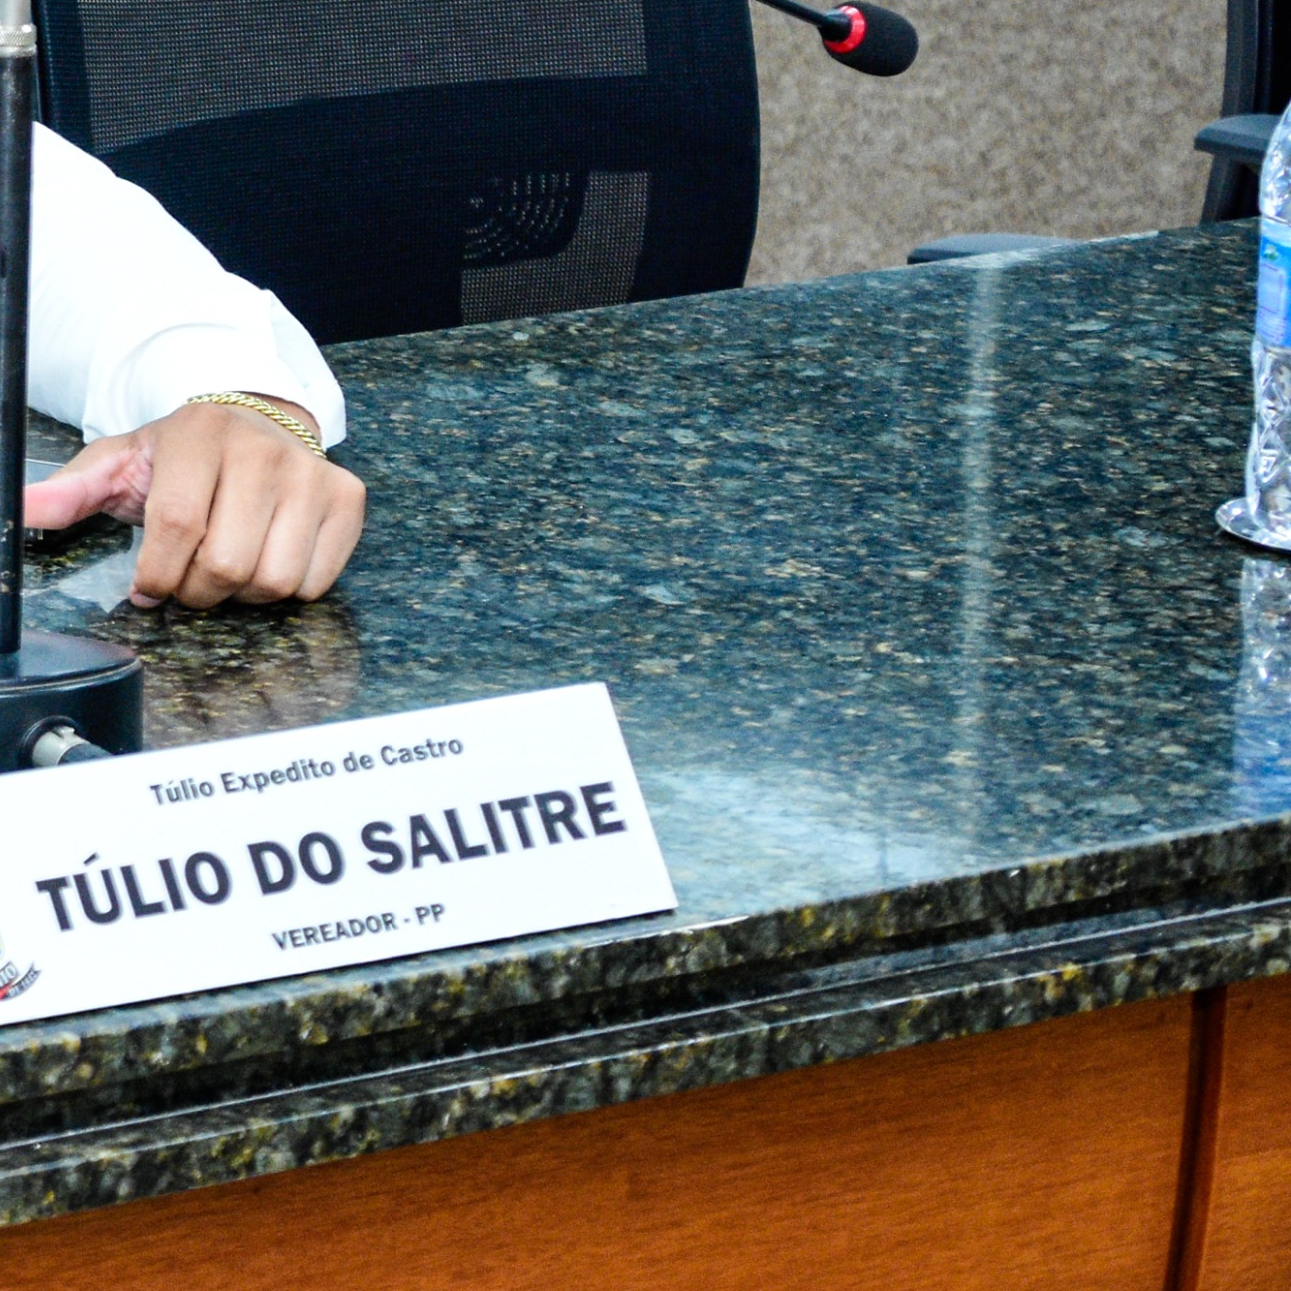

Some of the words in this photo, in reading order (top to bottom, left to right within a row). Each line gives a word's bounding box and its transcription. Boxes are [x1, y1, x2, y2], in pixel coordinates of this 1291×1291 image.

[149, 779, 215, 806] Túlio
[219, 759, 336, 794] Expedito
[342, 751, 375, 773] de
[380, 738, 464, 767] Castro
[34, 852, 232, 932] TÚLIO
[246, 831, 345, 896] DO
[360, 781, 627, 876] SALITRE
[271, 915, 398, 951] VEREADOR
[413, 903, 446, 926] PP
